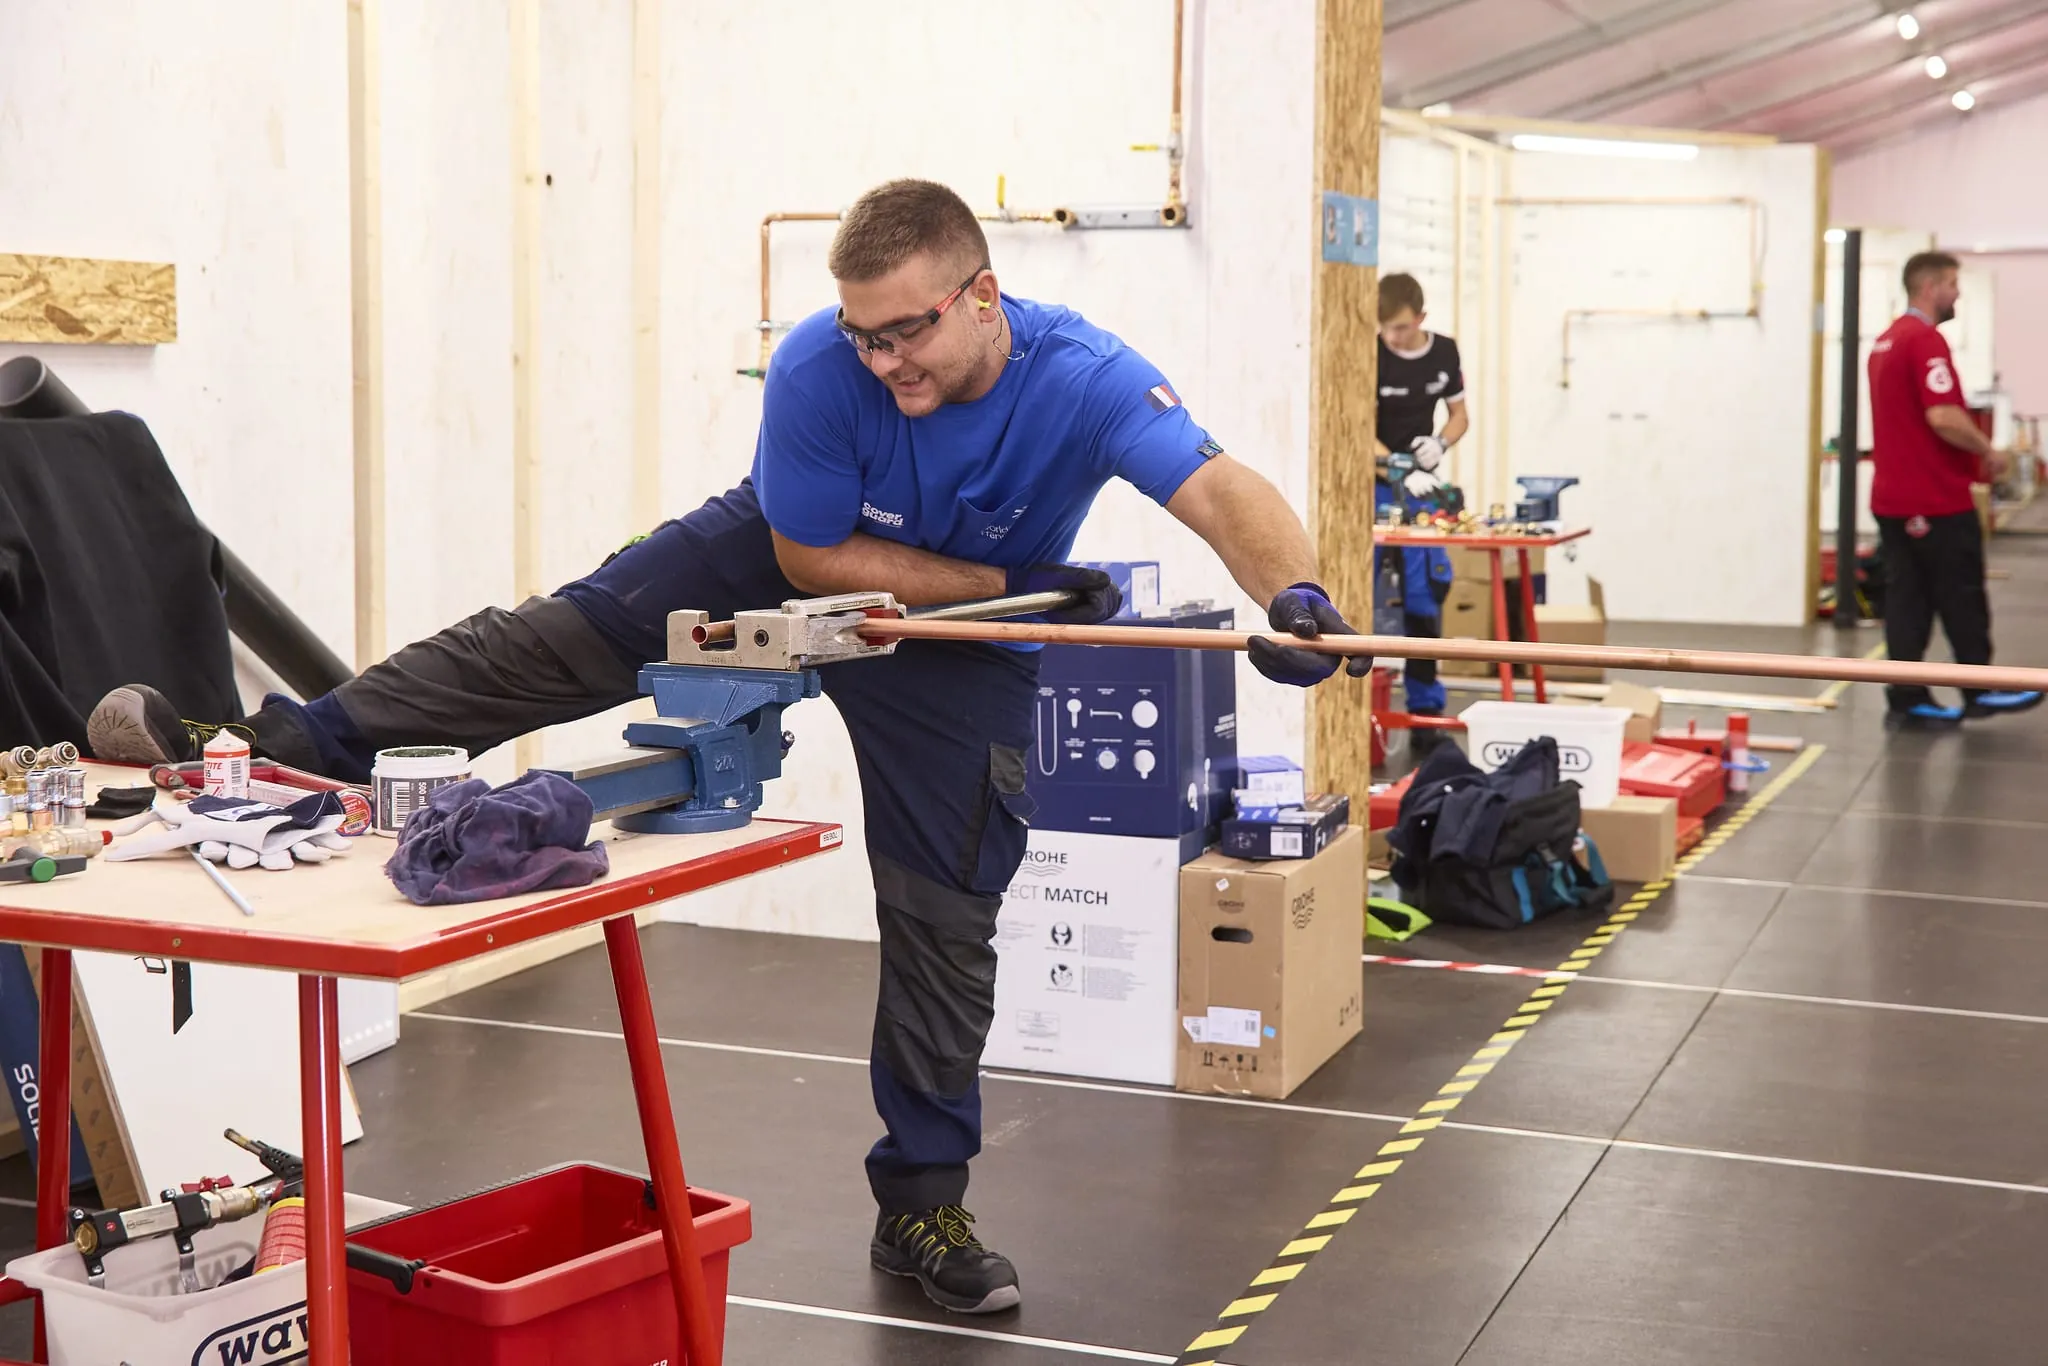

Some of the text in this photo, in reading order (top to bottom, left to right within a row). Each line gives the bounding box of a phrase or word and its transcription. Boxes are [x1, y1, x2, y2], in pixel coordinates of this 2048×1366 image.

[862, 507, 904, 527] guard
[863, 501, 903, 520] cover
[418, 781, 427, 795] 500
[1024, 850, 1069, 865] ROHE
[1008, 884, 1109, 906] ECT MATCH
